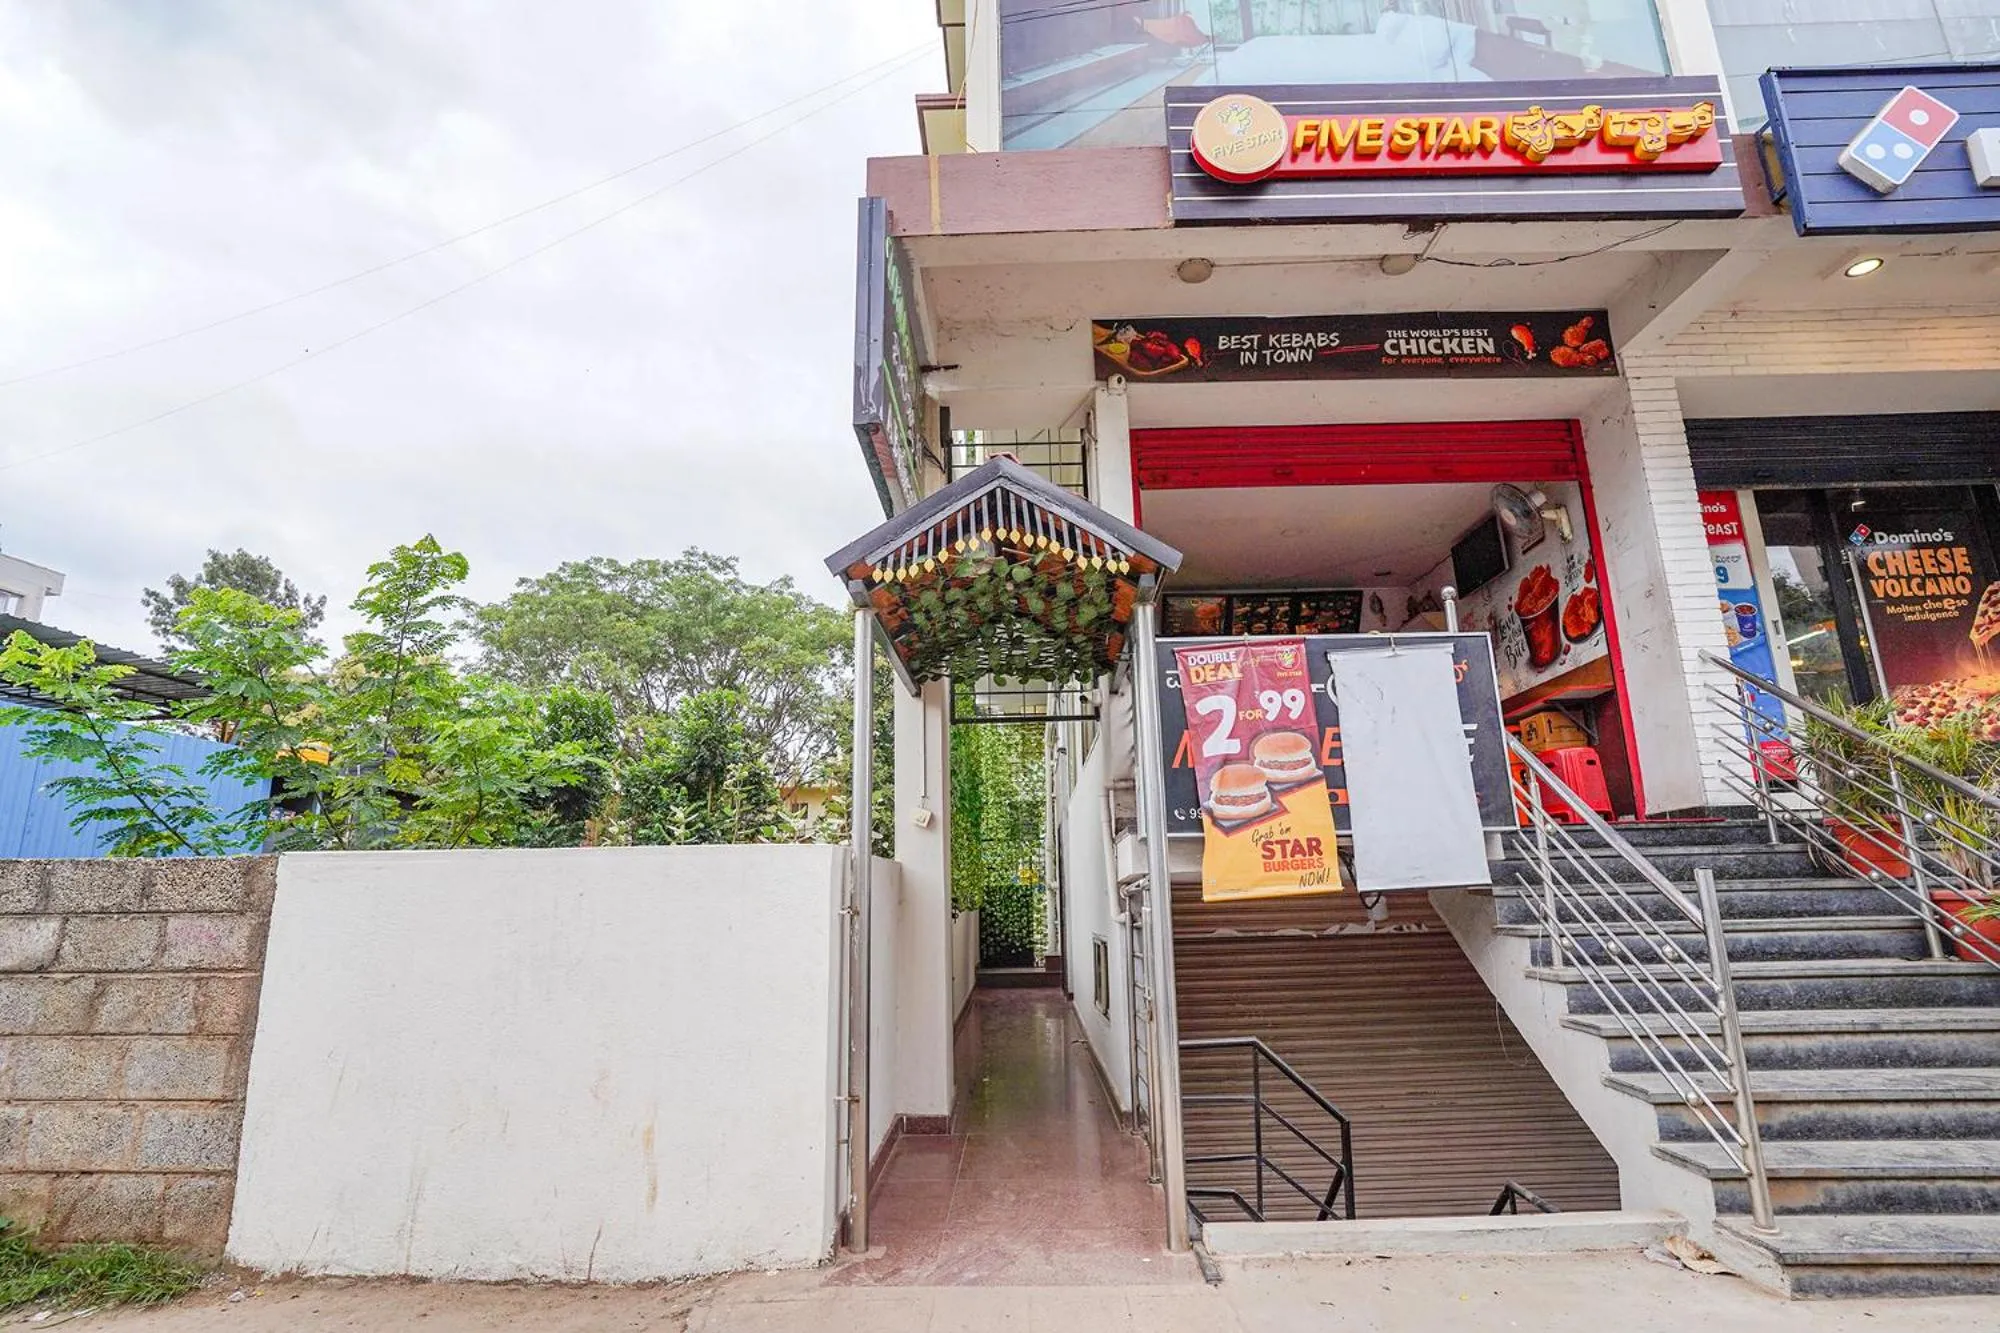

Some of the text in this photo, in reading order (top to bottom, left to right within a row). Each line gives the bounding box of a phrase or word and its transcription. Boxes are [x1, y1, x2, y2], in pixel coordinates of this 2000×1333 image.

[1293, 116, 1500, 153] FIVE STAR
[1210, 130, 1283, 159] FIVE STAR
[1218, 332, 1340, 350] BEST KEBABS
[1386, 328, 1489, 338] THE WORLD'S BEST
[1383, 337, 1496, 356] CHICKEN
[1240, 348, 1313, 366] IN TOWN
[1873, 528, 1955, 545] Domino's
[1867, 547, 1973, 577] CHEESE
[1715, 565, 1729, 584] 9
[1870, 575, 1973, 598] VOLCANO
[1886, 597, 1969, 615] Molten cheese
[1903, 610, 1960, 622] indulgence
[1187, 651, 1238, 666] DOUBLE
[1190, 662, 1244, 686] DEAL
[1195, 695, 1242, 758] 2
[1238, 709, 1265, 721] FOR
[1252, 826, 1274, 847] Grab
[1262, 836, 1323, 860] STAR
[1263, 858, 1325, 872] BURGERS
[1299, 867, 1330, 888] NOW!
